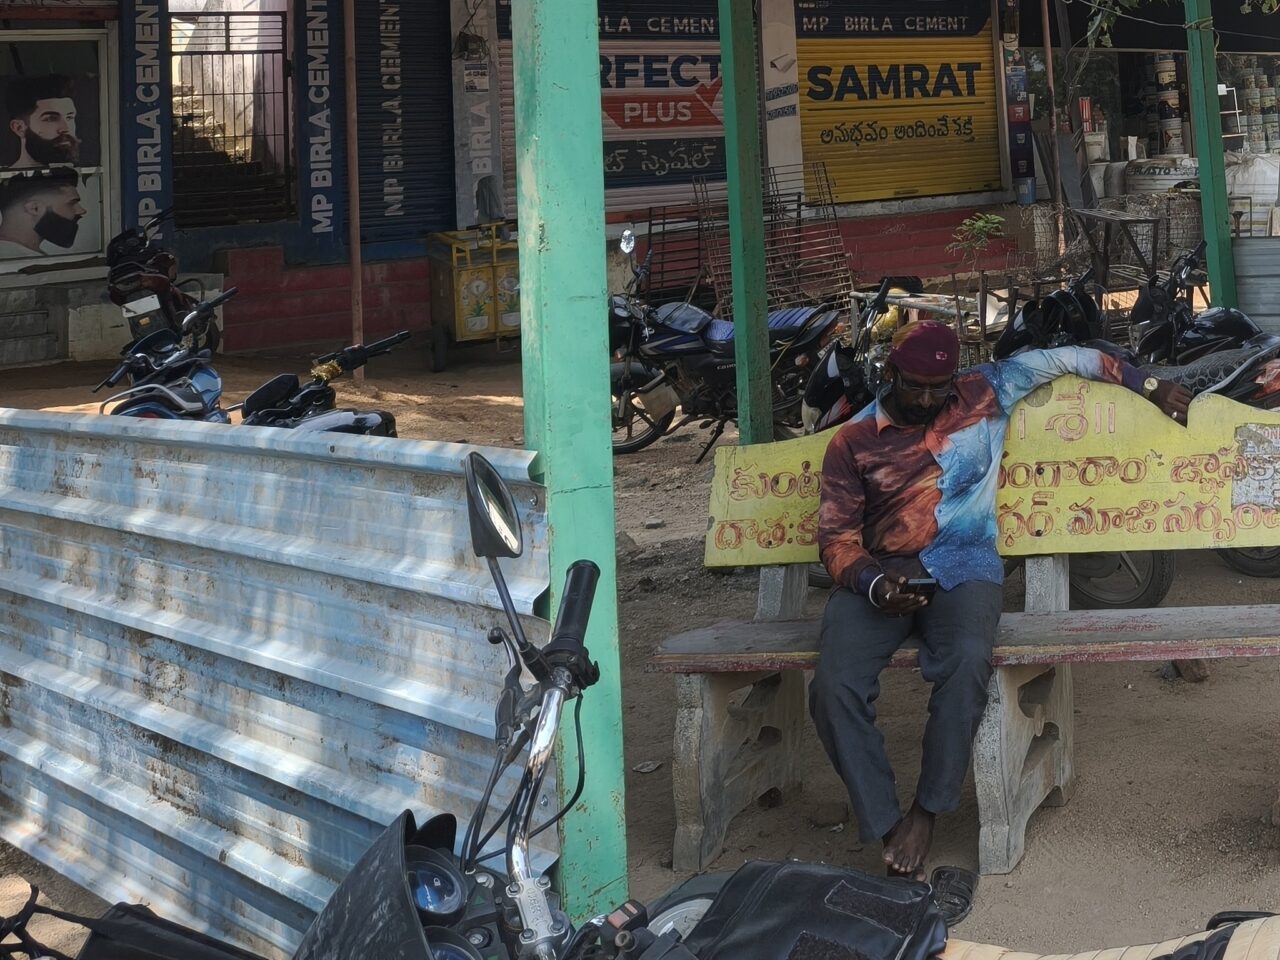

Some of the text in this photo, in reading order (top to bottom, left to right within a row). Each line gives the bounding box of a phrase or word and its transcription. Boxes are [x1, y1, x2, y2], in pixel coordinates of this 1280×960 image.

[647, 17, 717, 33] CEMEN
[803, 15, 969, 32] MP BIRLA CEMENT
[806, 62, 982, 102] SAMRAT
[624, 101, 692, 123] PLUS
[137, 108, 162, 192] BIRLA
[308, 109, 332, 188] BIRLA
[381, 95, 404, 172] BIRLA
[470, 100, 493, 174] BIRLA
[312, 194, 333, 233] MP
[383, 178, 404, 216] MP
[999, 450, 1149, 489] ంగారాం
[998, 490, 1055, 547] ధర్
